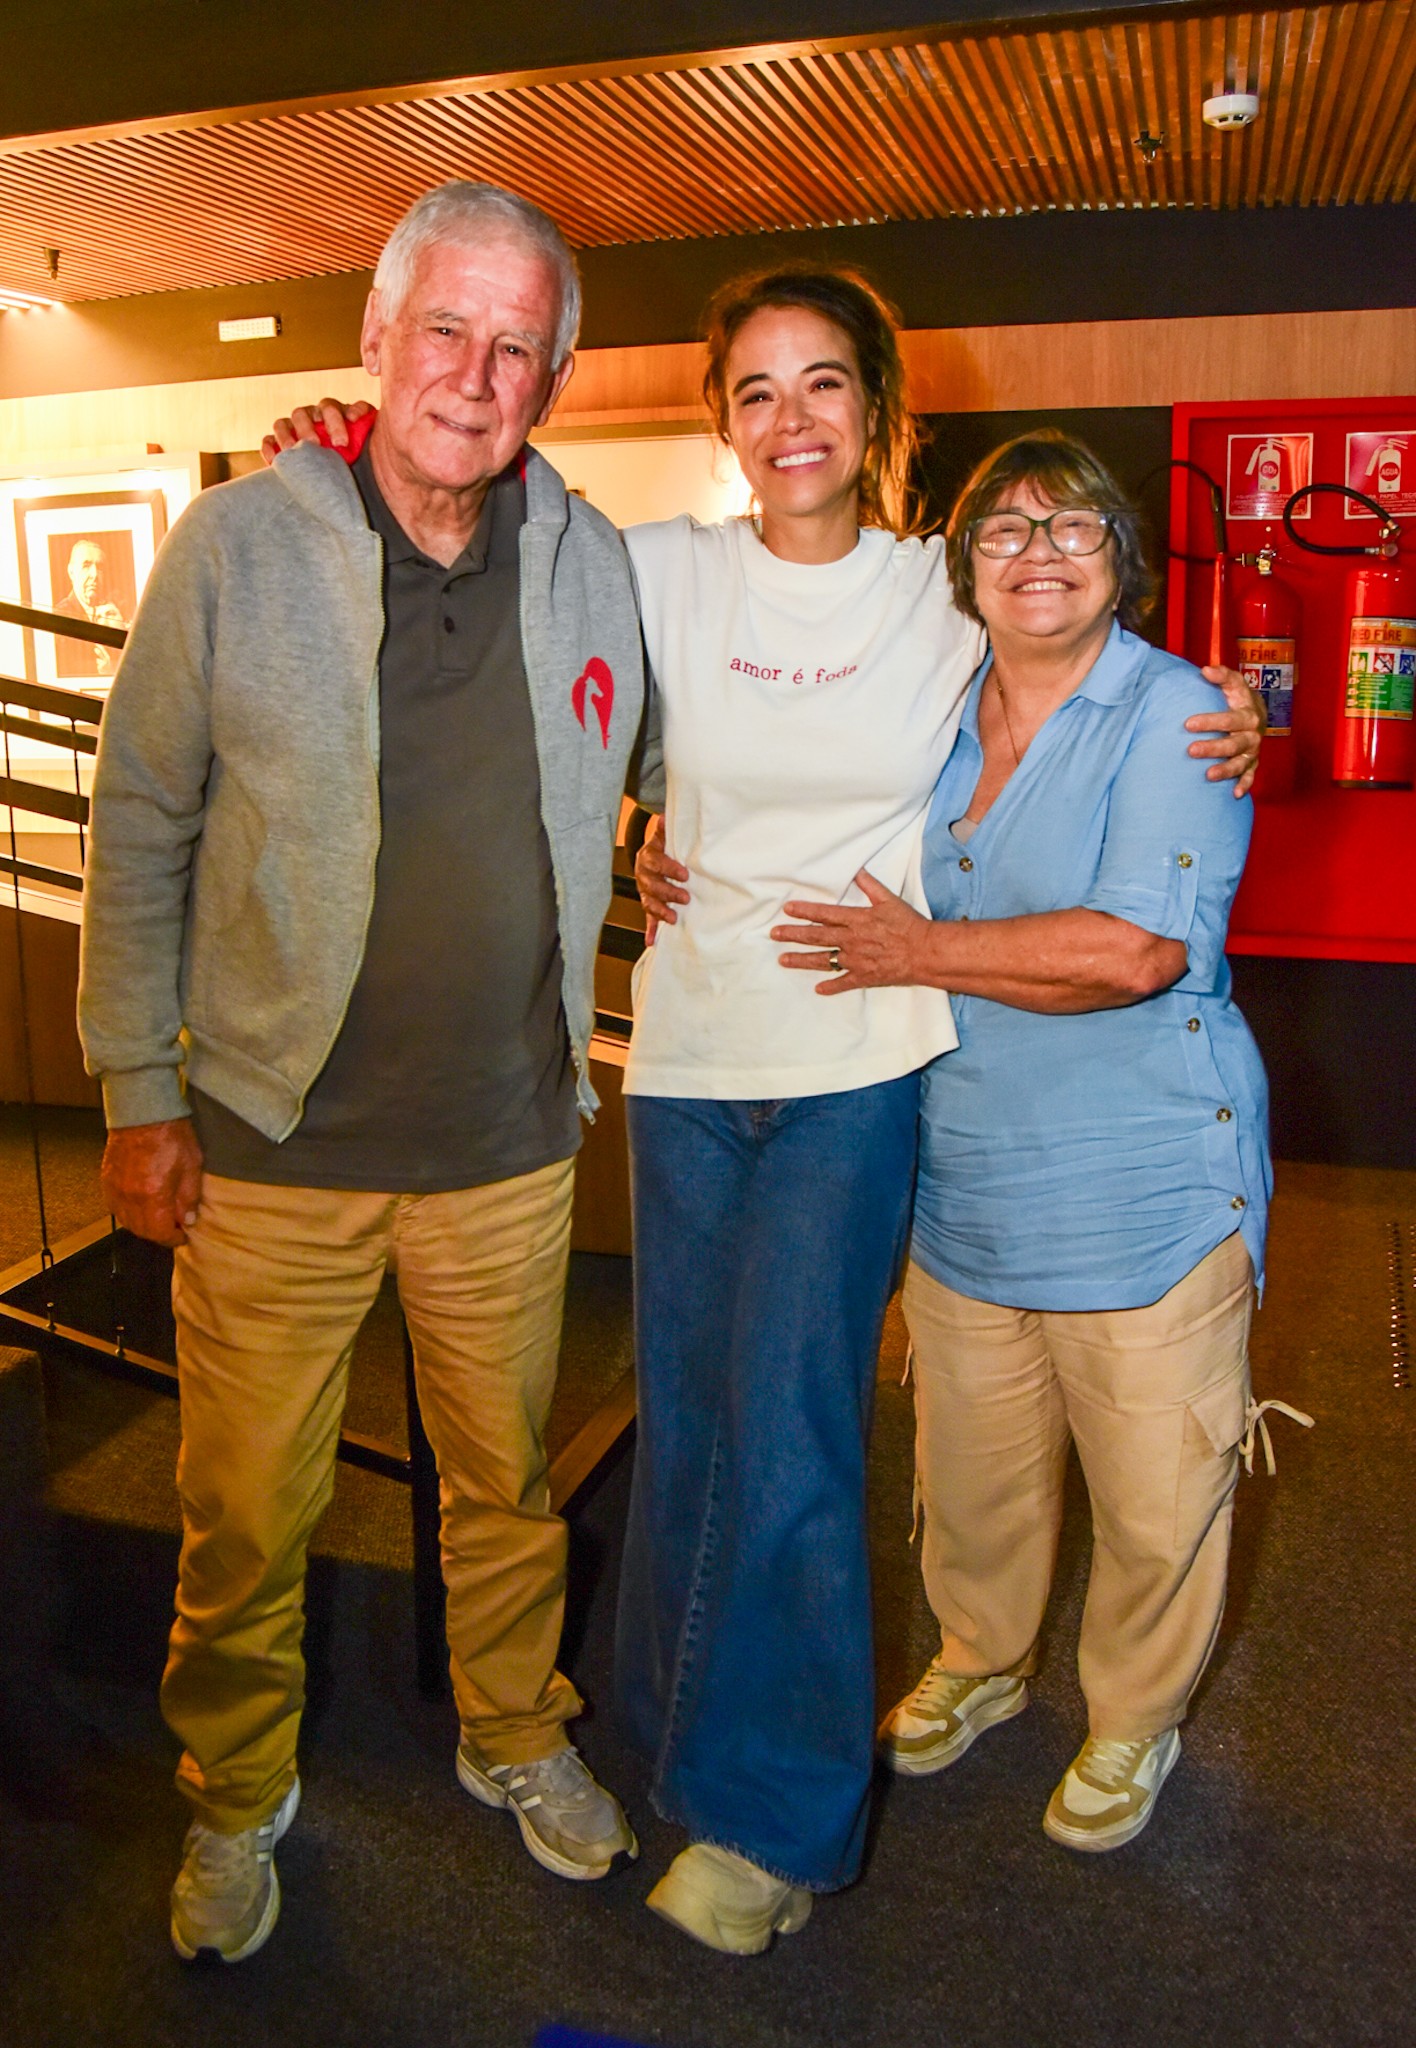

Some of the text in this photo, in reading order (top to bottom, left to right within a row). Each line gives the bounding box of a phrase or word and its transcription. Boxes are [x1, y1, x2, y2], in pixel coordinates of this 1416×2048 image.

[1380, 468, 1398, 476] AGUA
[1352, 627, 1402, 641] RED FIRE
[1250, 647, 1277, 661] FIRE
[730, 657, 858, 685] amor é foda
